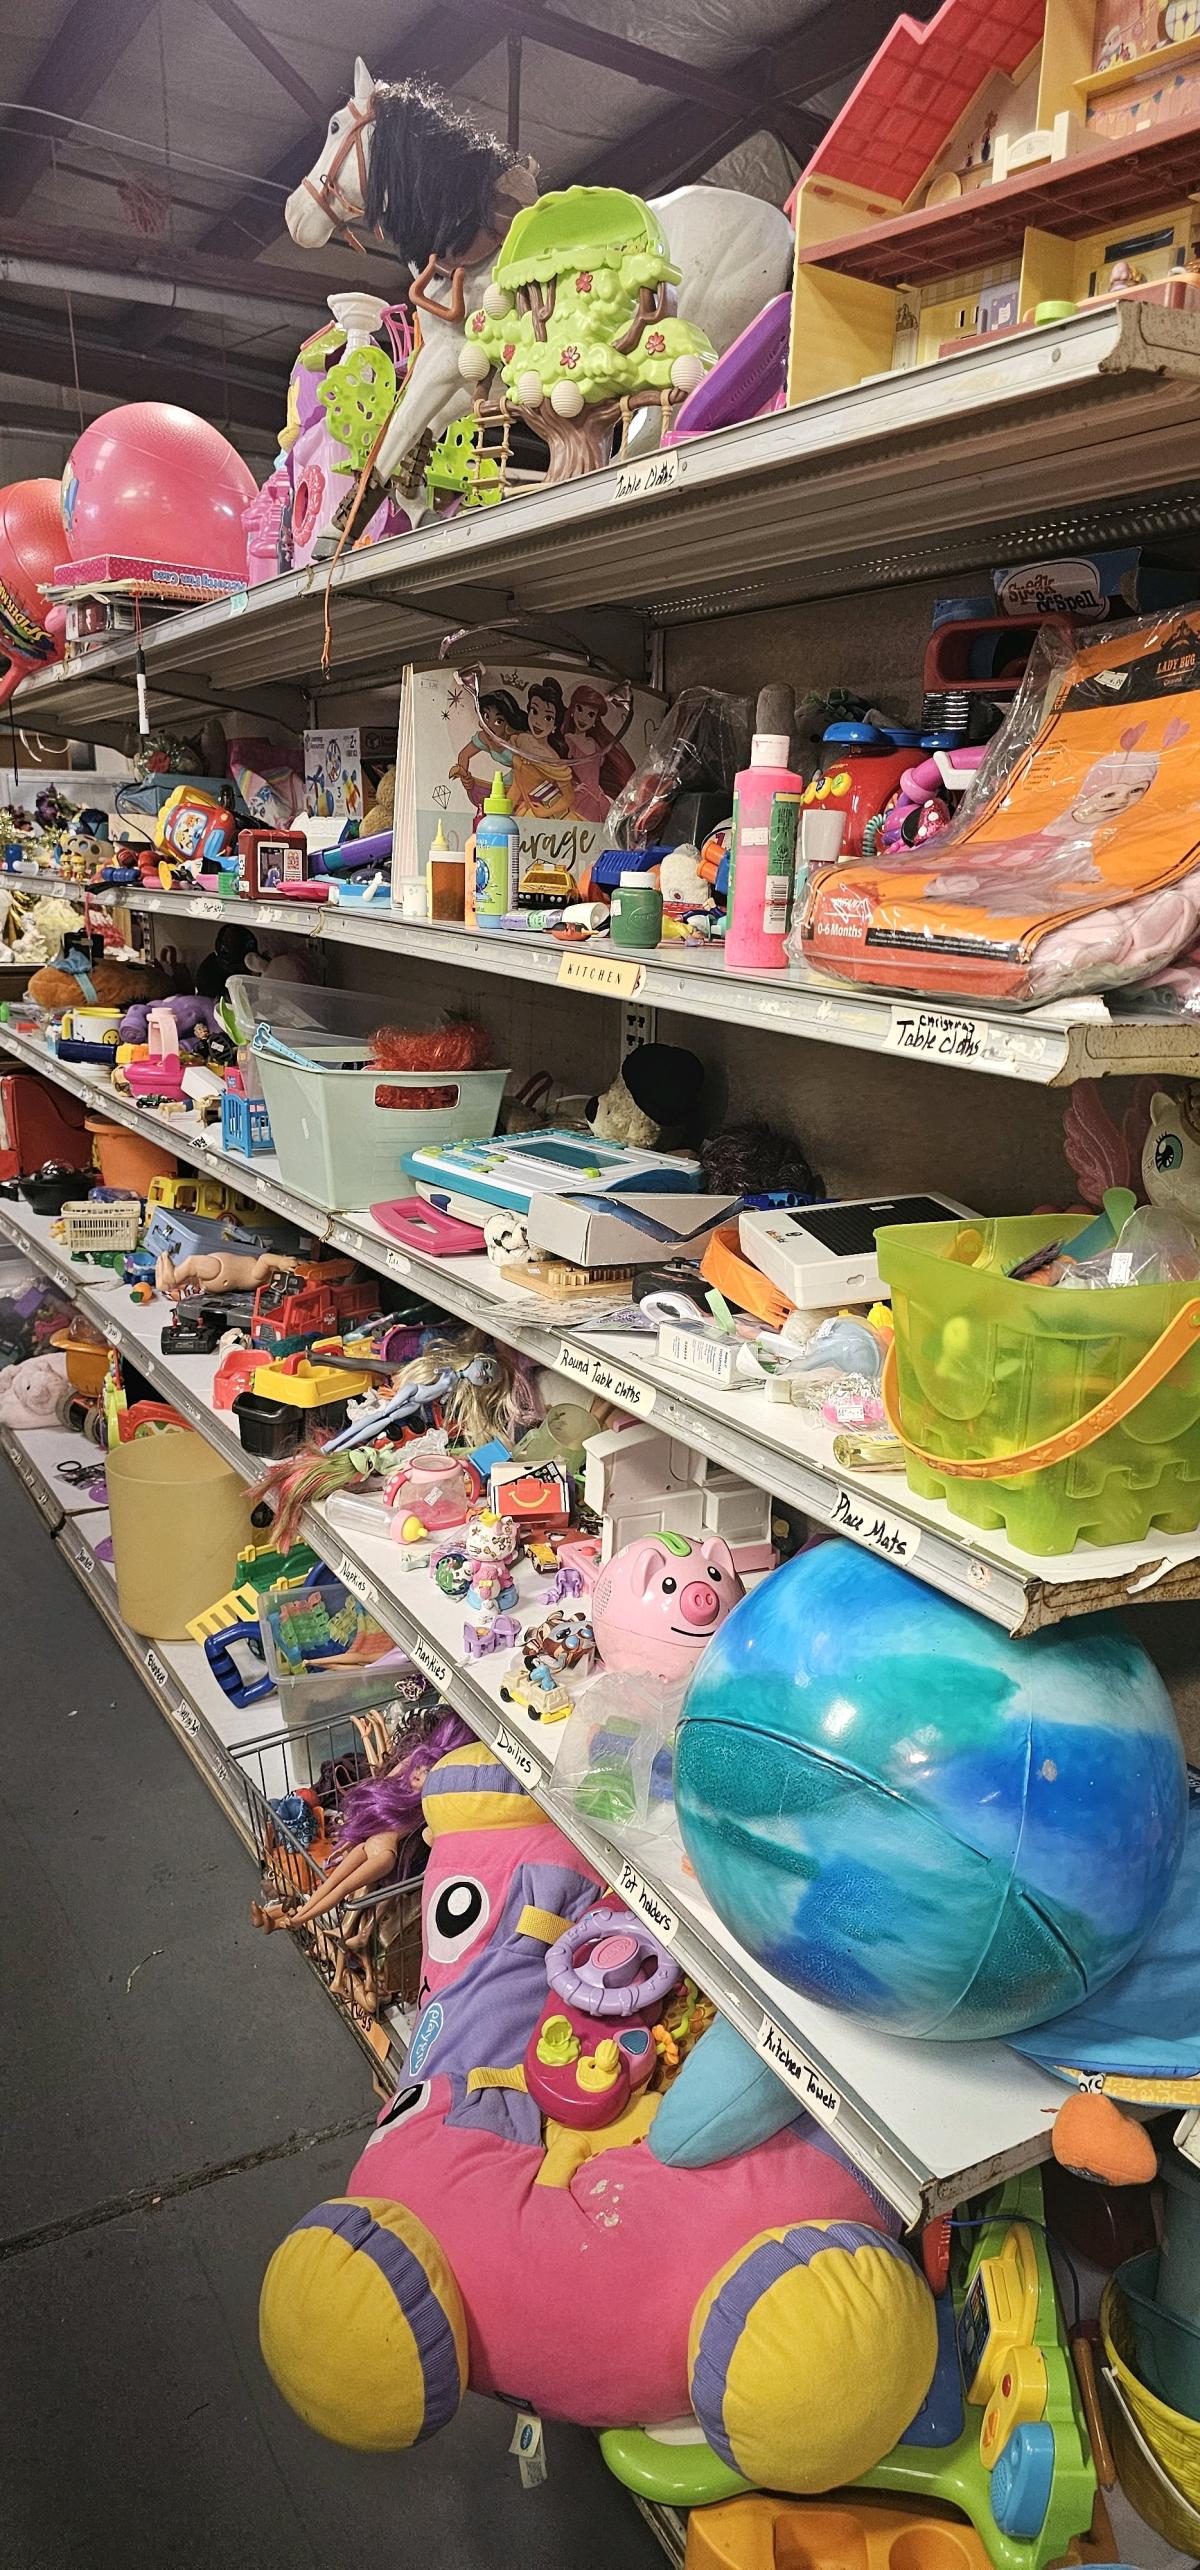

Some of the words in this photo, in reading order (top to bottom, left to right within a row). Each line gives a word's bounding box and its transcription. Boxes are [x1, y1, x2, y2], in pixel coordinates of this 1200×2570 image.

[615, 474, 641, 499] Table
[1007, 574, 1056, 605] Speak
[1156, 659, 1178, 675] LADY
[1179, 653, 1196, 667] BUG
[519, 826, 596, 872] urage
[817, 922, 830, 934] 0-6
[831, 924, 863, 938] Months
[567, 963, 623, 985] KITCHEN
[896, 1020, 937, 1051] Table
[560, 1348, 589, 1375] Round
[591, 1361, 613, 1388] Table
[831, 1491, 863, 1531] Place
[863, 1519, 907, 1555] Mats
[497, 1729, 532, 1774] Doilies
[620, 1865, 638, 1893] Pot
[763, 2026, 802, 2079] Kitchen
[803, 2065, 837, 2110] Towels
